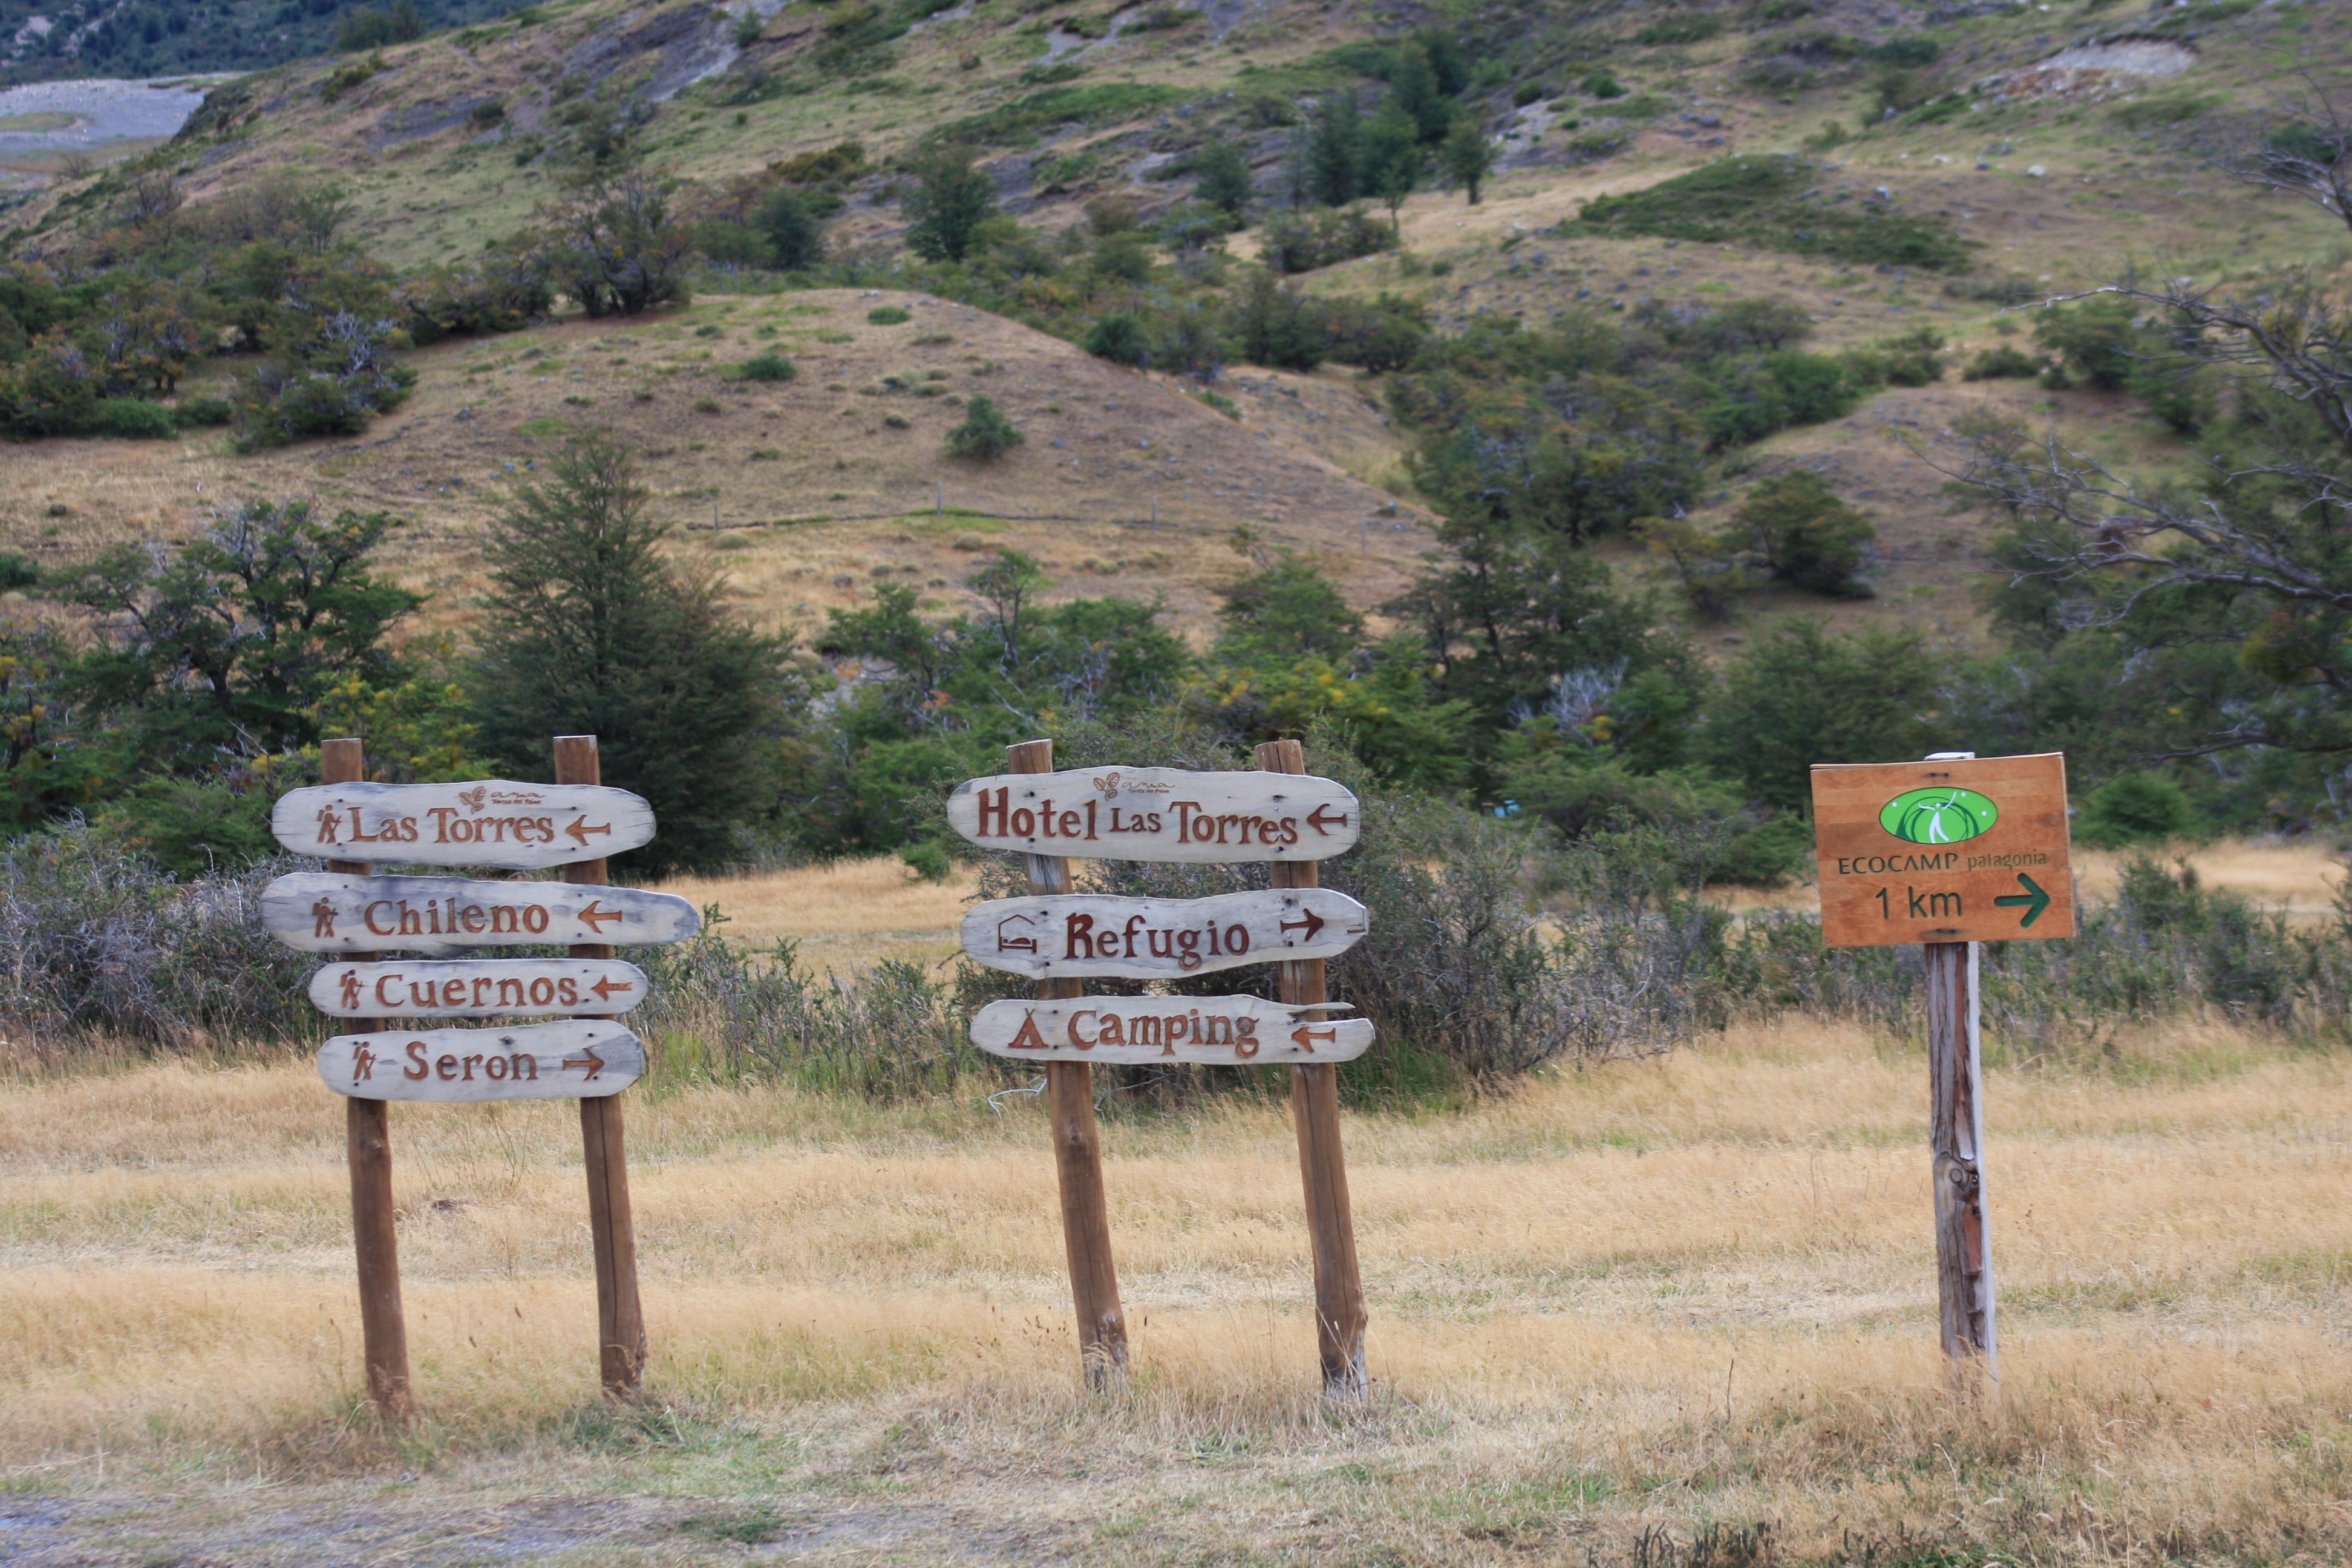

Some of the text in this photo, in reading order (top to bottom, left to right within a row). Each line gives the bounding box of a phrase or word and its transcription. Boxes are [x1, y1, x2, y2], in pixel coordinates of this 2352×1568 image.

[347, 807, 554, 843] Las Torres
[977, 786, 1298, 844] Hotel Las Torres
[1838, 850, 2047, 874] ECOCAMP patagonia
[364, 898, 549, 935] Chileno
[1875, 886, 1962, 920] 1 km
[1065, 912, 1250, 972] Refugio
[375, 975, 578, 1008] Cuernos
[1067, 1008, 1260, 1059] Camping
[403, 1041, 538, 1082] Seron
